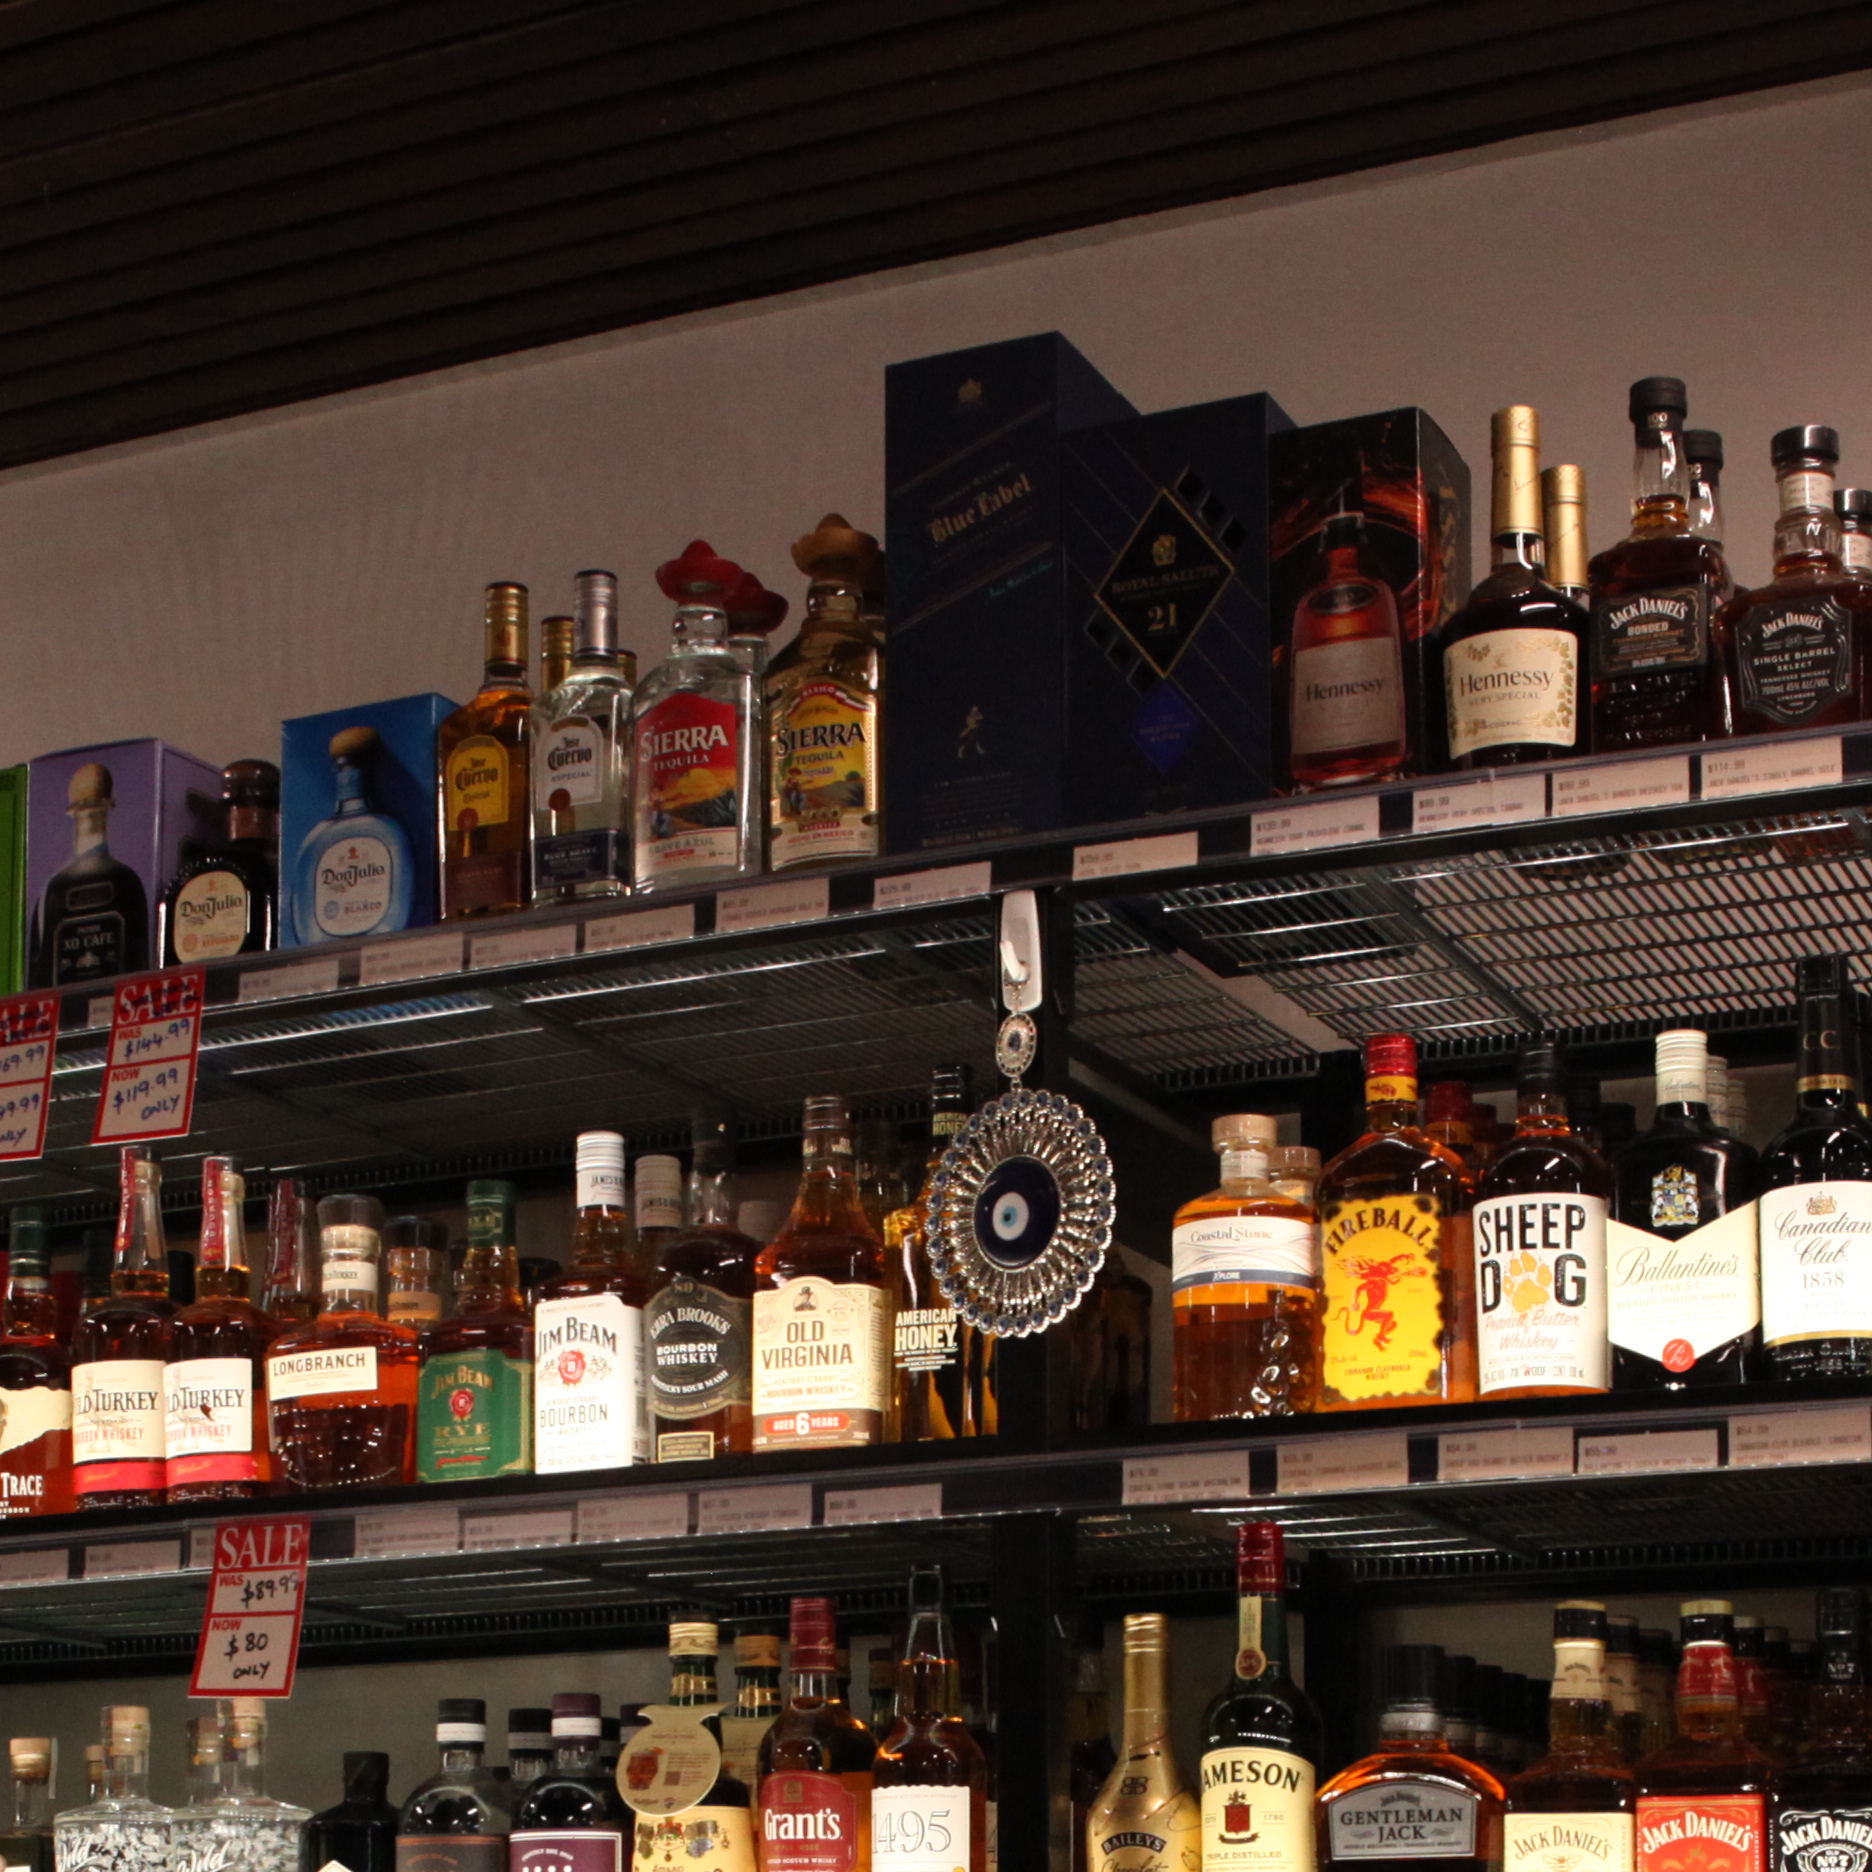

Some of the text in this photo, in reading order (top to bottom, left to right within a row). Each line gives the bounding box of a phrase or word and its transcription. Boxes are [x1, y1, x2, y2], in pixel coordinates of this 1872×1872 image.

[1304, 676, 1386, 701] Hennessy
[1458, 665, 1555, 696] Hennessy
[639, 725, 729, 759] SIERRA
[778, 720, 866, 754] SIERRA
[547, 743, 593, 769] Cuervo
[652, 752, 709, 770] TEQUILA
[795, 750, 845, 766] TEQUILA
[116, 973, 199, 1026] SALE
[112, 1068, 178, 1112] $119.99
[141, 1096, 180, 1120] ONLY
[1326, 1207, 1433, 1255] FIREBALL
[1478, 1202, 1586, 1257] SHEEP
[1774, 1211, 1872, 1240] Canadian
[676, 1305, 731, 1335] BROOKS
[895, 1308, 959, 1327] AMERICAN
[536, 1314, 617, 1363] JIM BEAM
[785, 1318, 824, 1344] OLD
[272, 1352, 366, 1378] LONGBRANCH
[657, 1351, 719, 1366] WHISKEY
[761, 1342, 854, 1371] VIRGINIA
[92, 1390, 159, 1412] TURKEY
[181, 1388, 246, 1409] TURKEY
[540, 1402, 609, 1429] BOURBON
[0, 1471, 43, 1499] TRACE
[218, 1524, 303, 1570] SALE
[218, 1575, 244, 1586] WAS
[212, 1620, 242, 1630] NOW
[233, 1661, 270, 1679] ONLY
[1339, 1807, 1464, 1827] GENTLEMAN
[1103, 1833, 1166, 1853] BAILEYS
[1378, 1825, 1427, 1844] JACK
[1514, 1824, 1612, 1862] JACK DANIEL'S
[1640, 1811, 1754, 1854] JACK DANIEL'S
[1779, 1823, 1823, 1857] JACK
